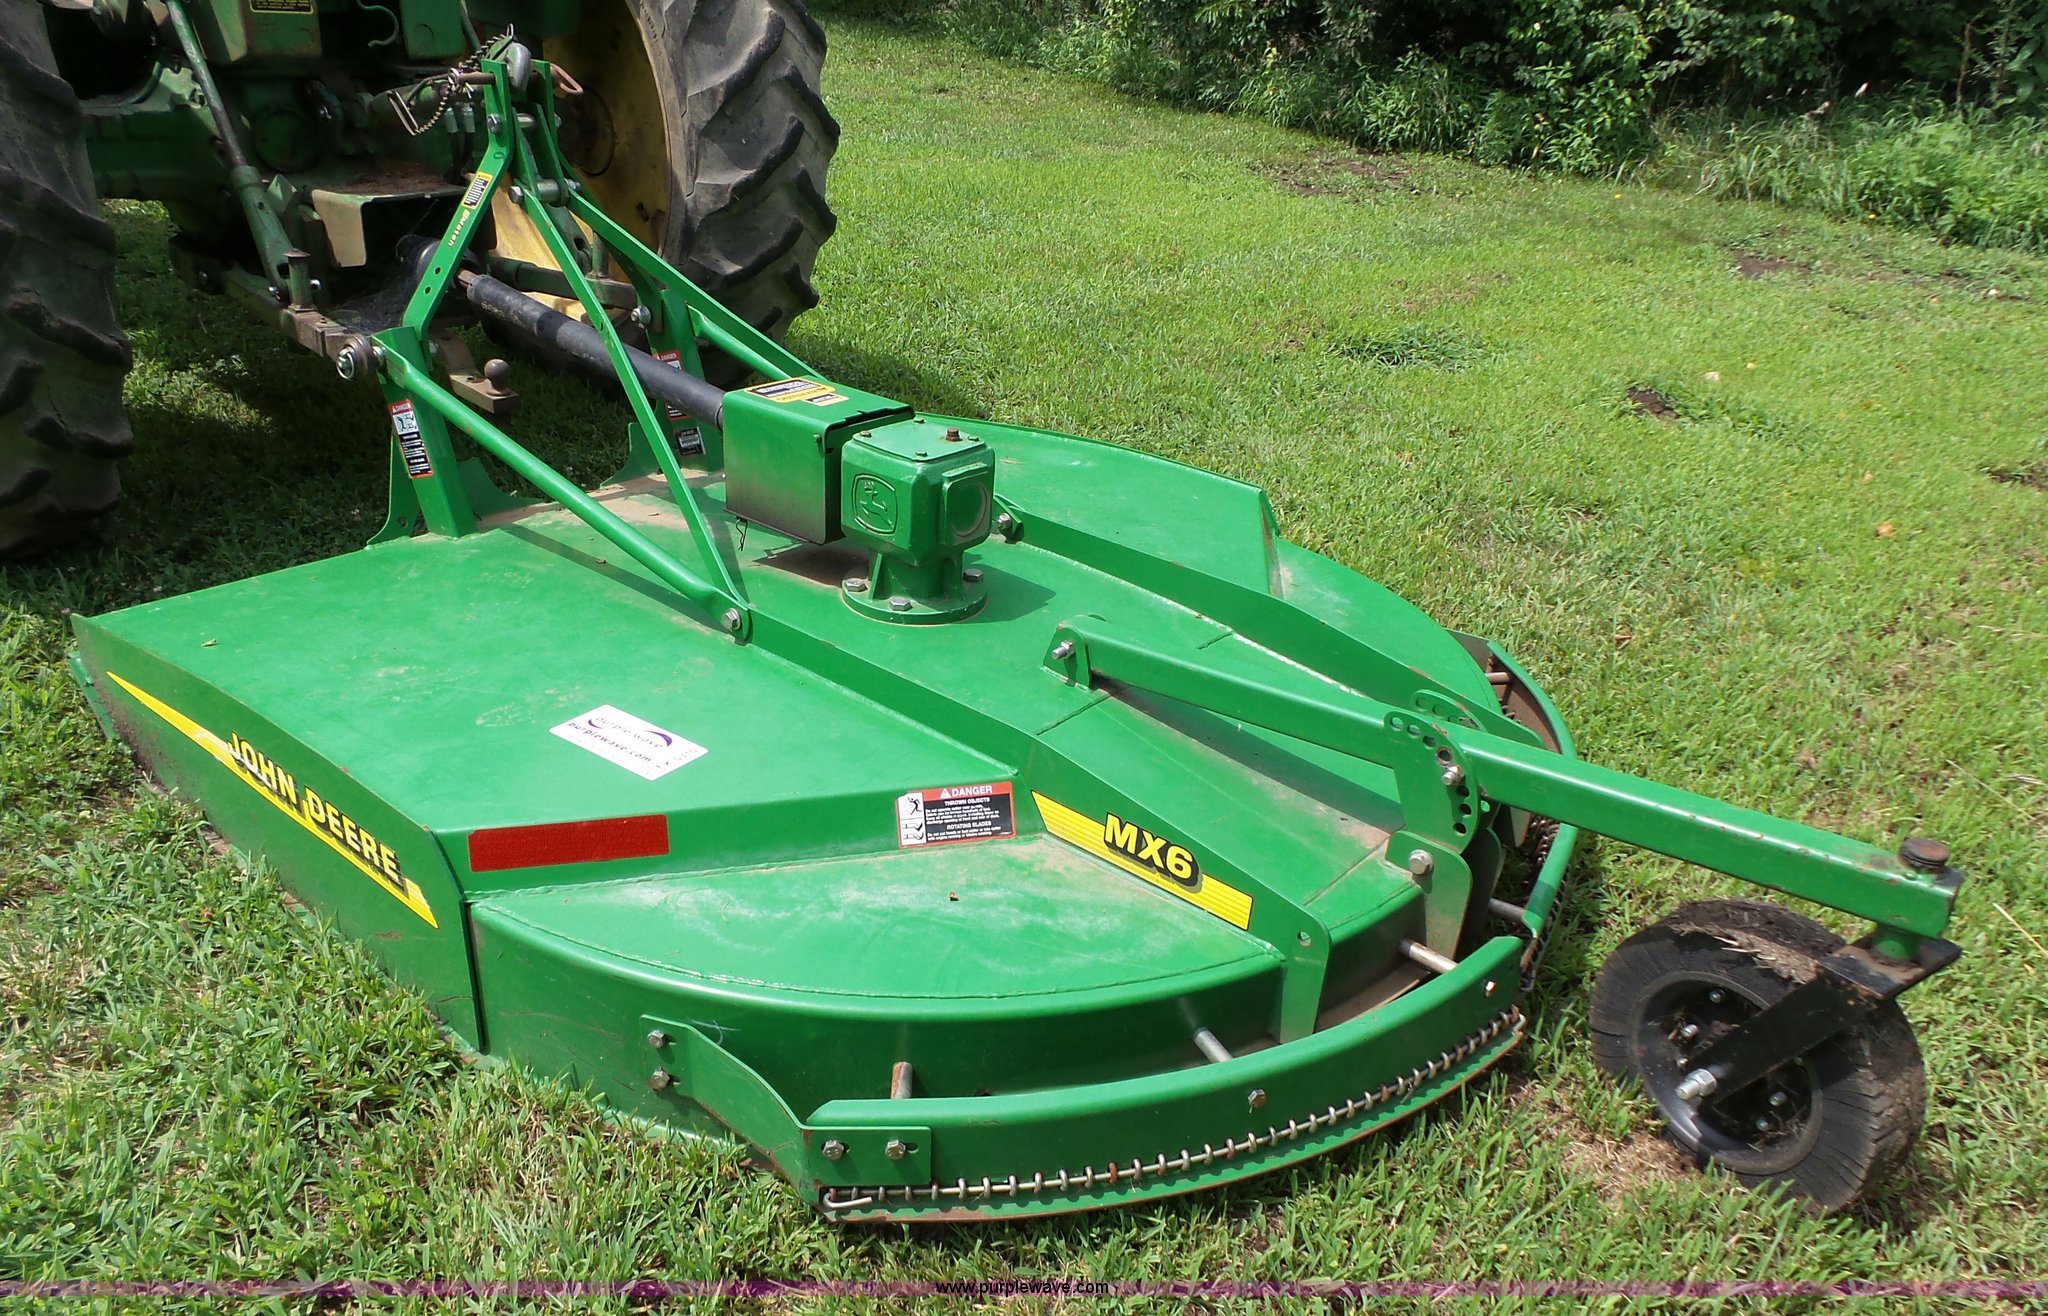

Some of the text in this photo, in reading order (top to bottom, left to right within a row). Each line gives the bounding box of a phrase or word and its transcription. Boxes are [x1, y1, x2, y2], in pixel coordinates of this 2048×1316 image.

[567, 722, 652, 762] purplewave.com
[228, 731, 400, 882] JOHN DEERE
[951, 785, 992, 797] DANGER
[1104, 812, 1197, 884] MX6
